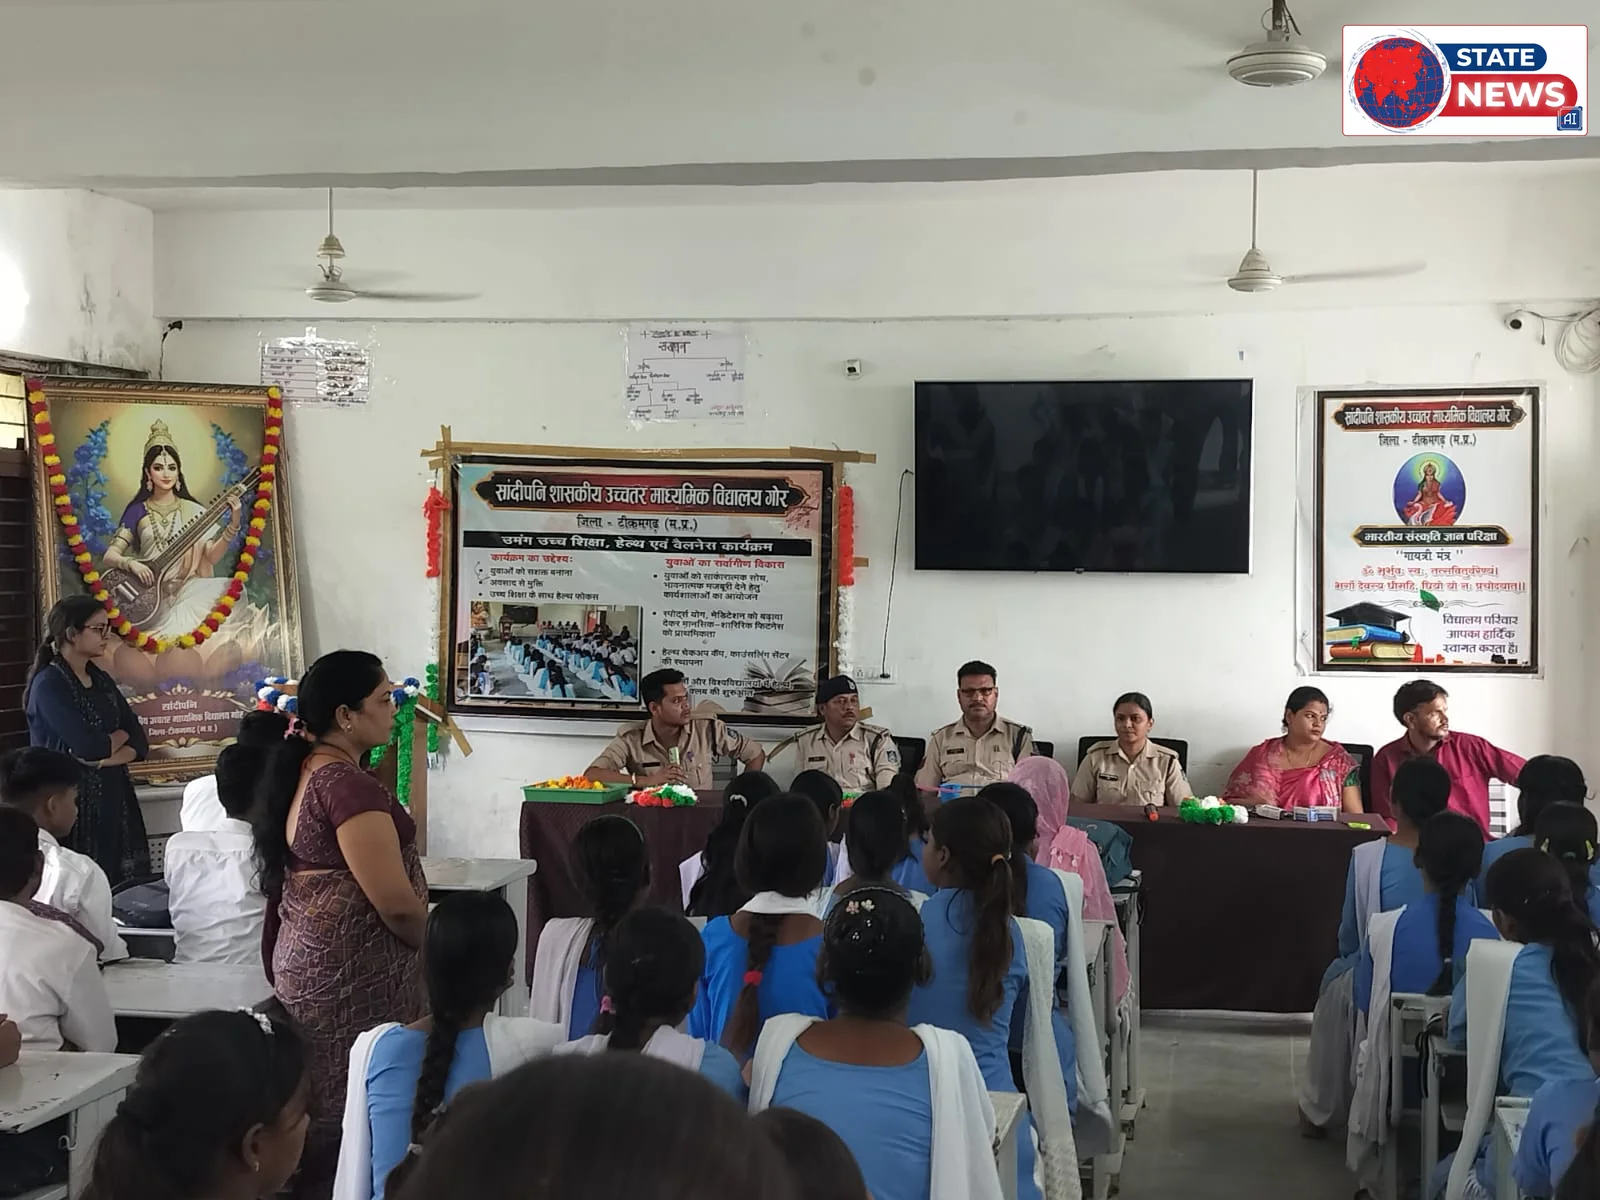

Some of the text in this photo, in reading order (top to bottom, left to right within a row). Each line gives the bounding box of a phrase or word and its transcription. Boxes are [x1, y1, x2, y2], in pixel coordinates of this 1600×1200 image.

[1345, 406, 1511, 425] सांदीपनि शासकीय उच्चतर माध्यमिक विद्यालय गोर
[1379, 433, 1399, 446] जिला
[1412, 433, 1445, 448] टीकमगढ़
[1450, 433, 1477, 447] (म.प्र.)
[495, 479, 790, 508] सांदीपनि शासकीय उच्चतर माध्यमिक विद्यालय गोर
[576, 514, 602, 528] जिला
[617, 515, 659, 533] टीकमगढ़
[664, 517, 698, 531] (म.प्र.)
[1364, 530, 1498, 543] भारतीय संस्कृति ज्ञान परिक्षा
[501, 534, 773, 552] उमंग उच्च शिक्षा, हेल्थ एवं वैलनेस कार्यक्रम
[491, 552, 524, 562] कार्यक्रम
[527, 554, 539, 562] का
[665, 557, 695, 569] युवाओं
[698, 559, 711, 567] का
[754, 558, 785, 568] विकास
[490, 567, 514, 576] युवाओं
[515, 567, 525, 575] को
[527, 568, 548, 576] सशक्त
[664, 571, 690, 581] युवाओं
[690, 571, 701, 580] को
[490, 578, 544, 589] अवसाद से मुक्ति
[663, 582, 704, 590] भावनात्मक
[734, 582, 746, 591] देने
[748, 582, 760, 593] हेतु
[490, 589, 599, 600] उच्च शिक्षा के साथ हेल्थ फोकस
[663, 590, 758, 600] कार्यशालाओं का आयोजन
[711, 609, 745, 620] मेडिटेशन
[747, 611, 758, 620] को
[1443, 613, 1518, 625] विद्यालय परिवार
[662, 619, 680, 628] देकर
[754, 621, 784, 630] फिटनेस
[662, 629, 716, 638] को प्राथमिकता
[1446, 627, 1515, 640] आपका हार्दिक
[662, 647, 680, 657] हेल्थ
[1443, 643, 1476, 653] स्वागत
[1479, 644, 1506, 653] करता
[661, 657, 703, 667] की स्थापना
[691, 677, 707, 686] और
[709, 687, 720, 696] की
